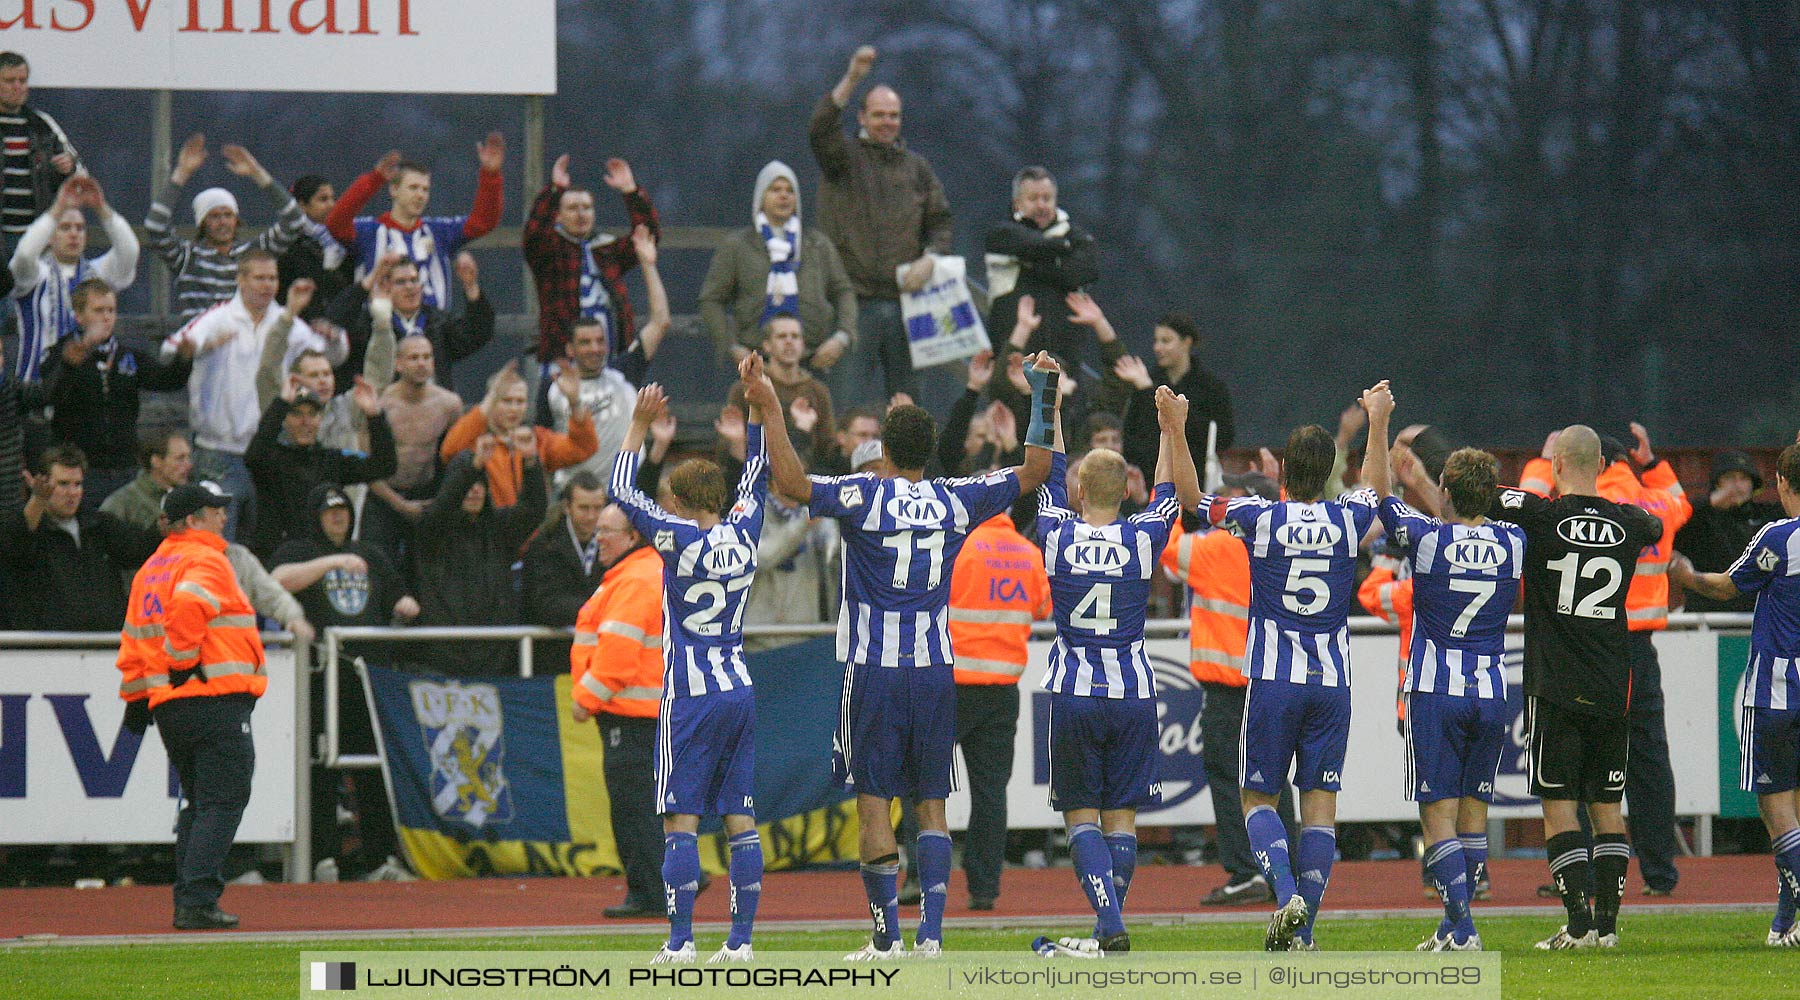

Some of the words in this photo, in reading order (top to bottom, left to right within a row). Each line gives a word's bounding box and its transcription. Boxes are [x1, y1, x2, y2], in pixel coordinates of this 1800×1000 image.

[898, 499, 939, 520] KIA
[1287, 526, 1332, 544] KIA
[1569, 519, 1617, 543] KIA
[712, 548, 743, 569] KIA
[882, 530, 946, 590] 11
[1074, 546, 1121, 565] KIA
[1455, 544, 1498, 564] KIA
[990, 578, 1029, 602] ICA
[1281, 558, 1331, 616] 5
[1546, 552, 1623, 619] 12
[143, 593, 163, 616] CA
[682, 571, 756, 636] 27
[1069, 582, 1118, 635] 4
[1449, 578, 1497, 638] 7
[1322, 770, 1340, 783] ICA
[664, 880, 677, 915] SKF
[1088, 873, 1110, 908] SKF
[870, 902, 887, 933] SKF
